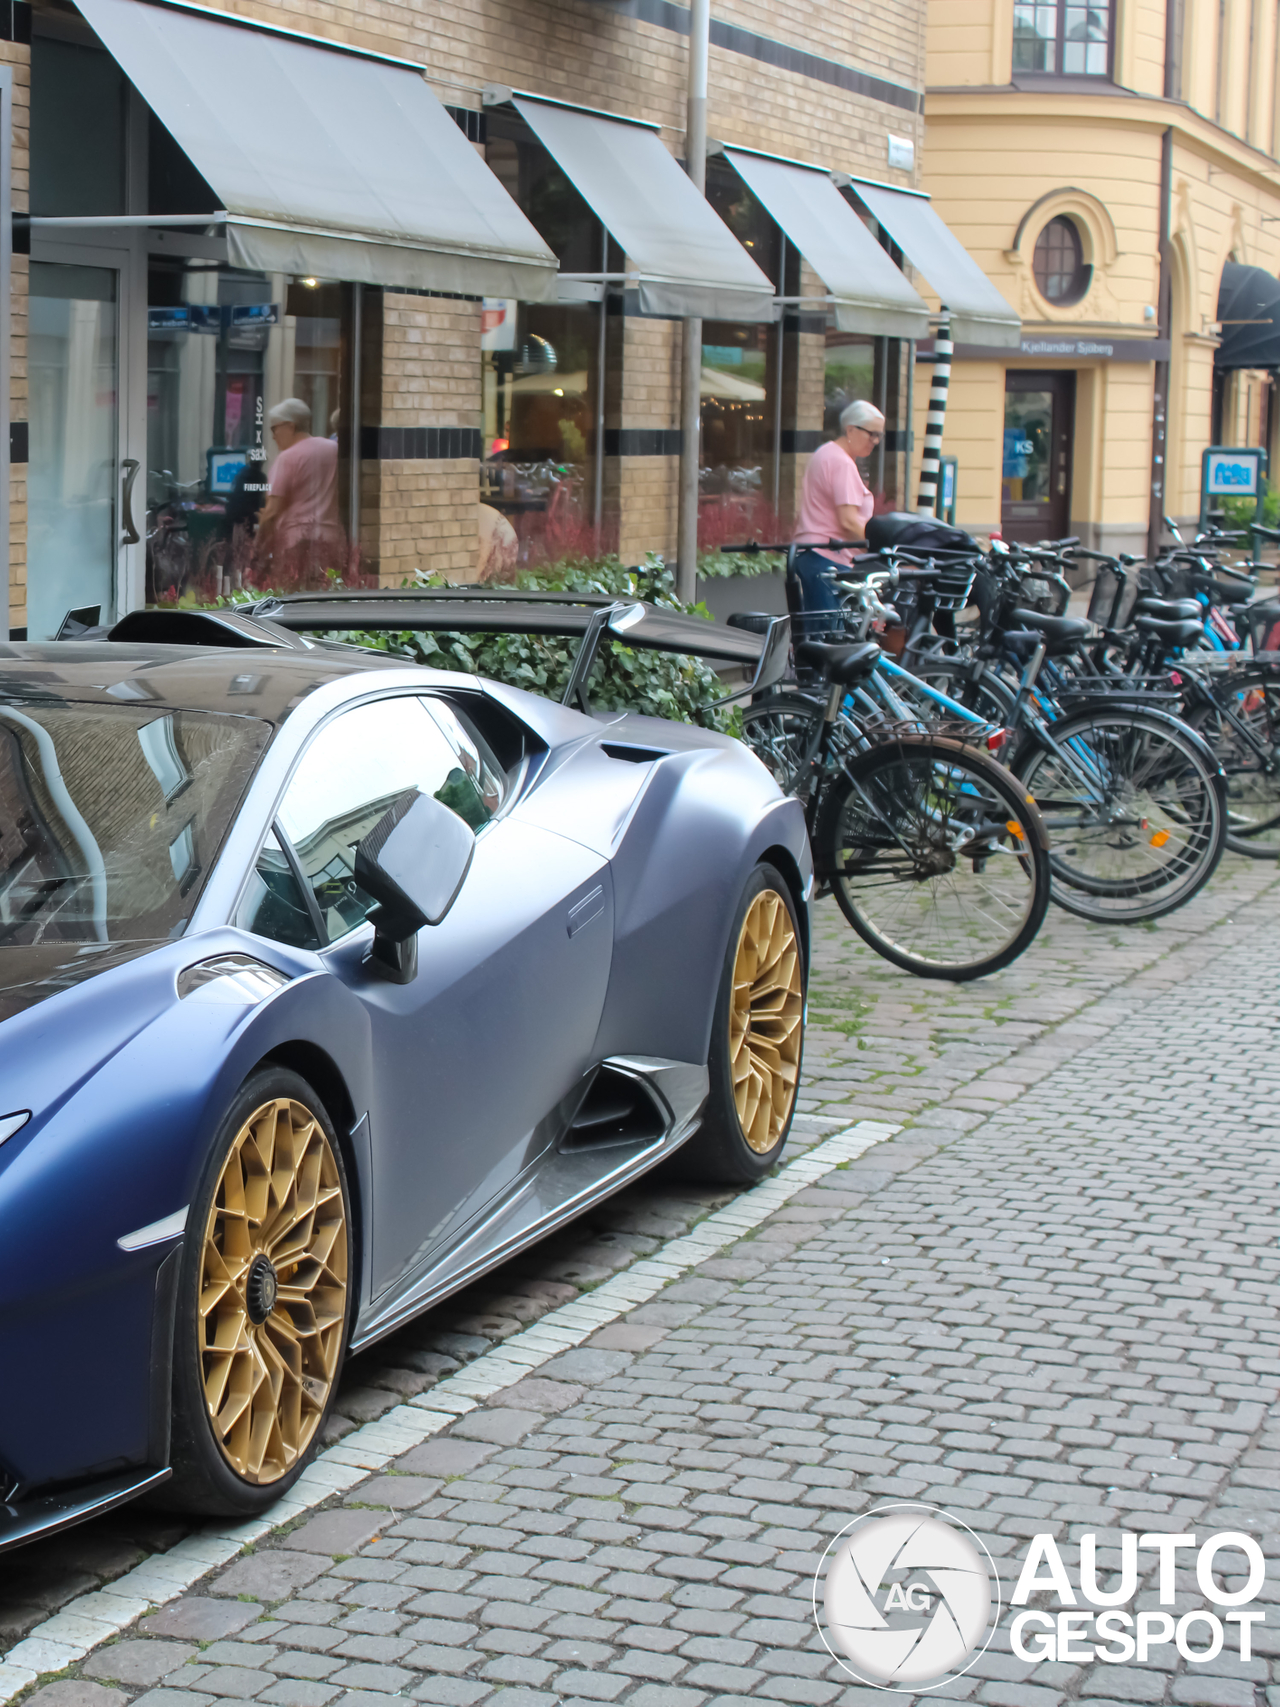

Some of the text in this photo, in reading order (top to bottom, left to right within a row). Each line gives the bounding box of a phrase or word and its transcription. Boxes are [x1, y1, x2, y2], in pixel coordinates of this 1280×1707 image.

[1020, 340, 1114, 357] Kjellander Sjöberg
[1014, 439, 1034, 455] KS
[243, 483, 272, 492] FIREPLACE
